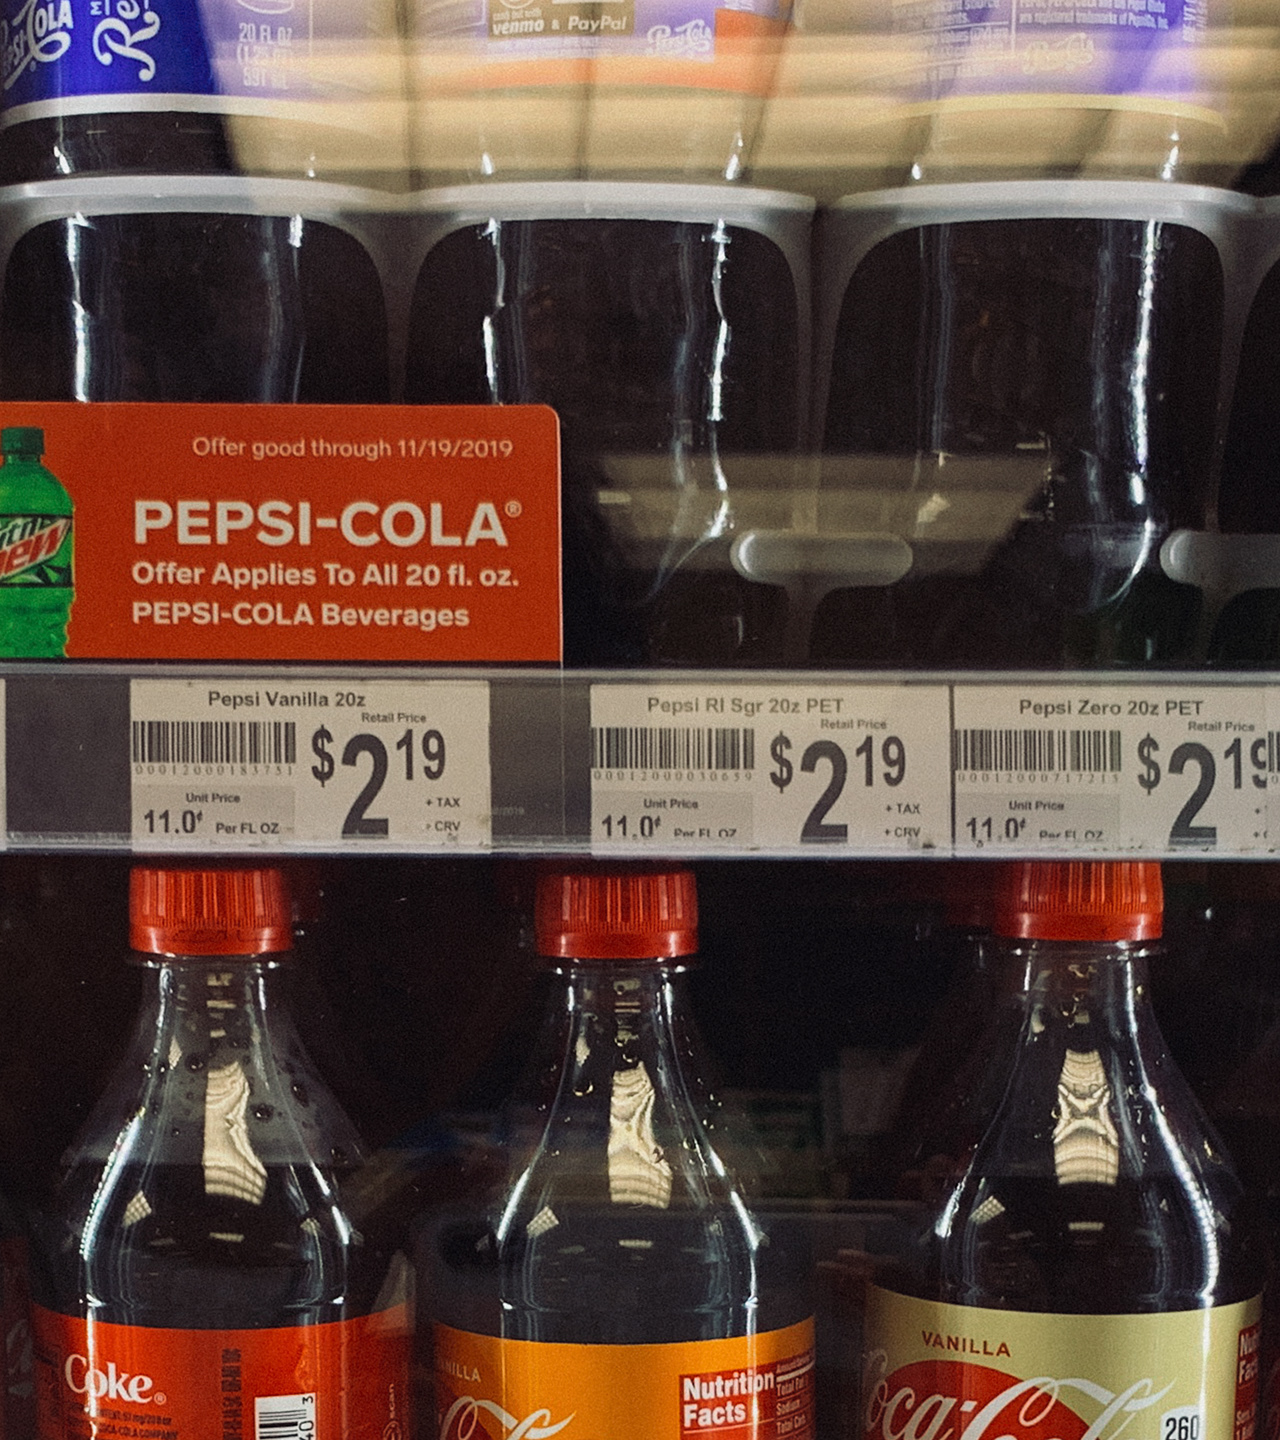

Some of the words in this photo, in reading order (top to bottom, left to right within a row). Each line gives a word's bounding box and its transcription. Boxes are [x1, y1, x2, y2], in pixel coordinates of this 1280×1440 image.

[193, 437, 247, 457] Offer
[252, 439, 305, 462] good
[311, 439, 390, 461] through
[397, 438, 512, 459] 11/19/2019
[132, 562, 207, 586] Offer
[212, 562, 316, 590] Applies
[323, 564, 355, 586] To
[363, 564, 398, 586] All
[406, 564, 441, 586] 20
[448, 564, 474, 586] fl.
[480, 568, 518, 586] oz.
[133, 602, 313, 625] PEPSI-COLA
[322, 602, 468, 630] Beverages
[209, 690, 259, 709] Pepsi
[265, 690, 328, 708] Vanilla
[921, 1330, 1011, 1357] VANILLA
[683, 1371, 774, 1400] Nutrition
[683, 1401, 746, 1426] Facts
